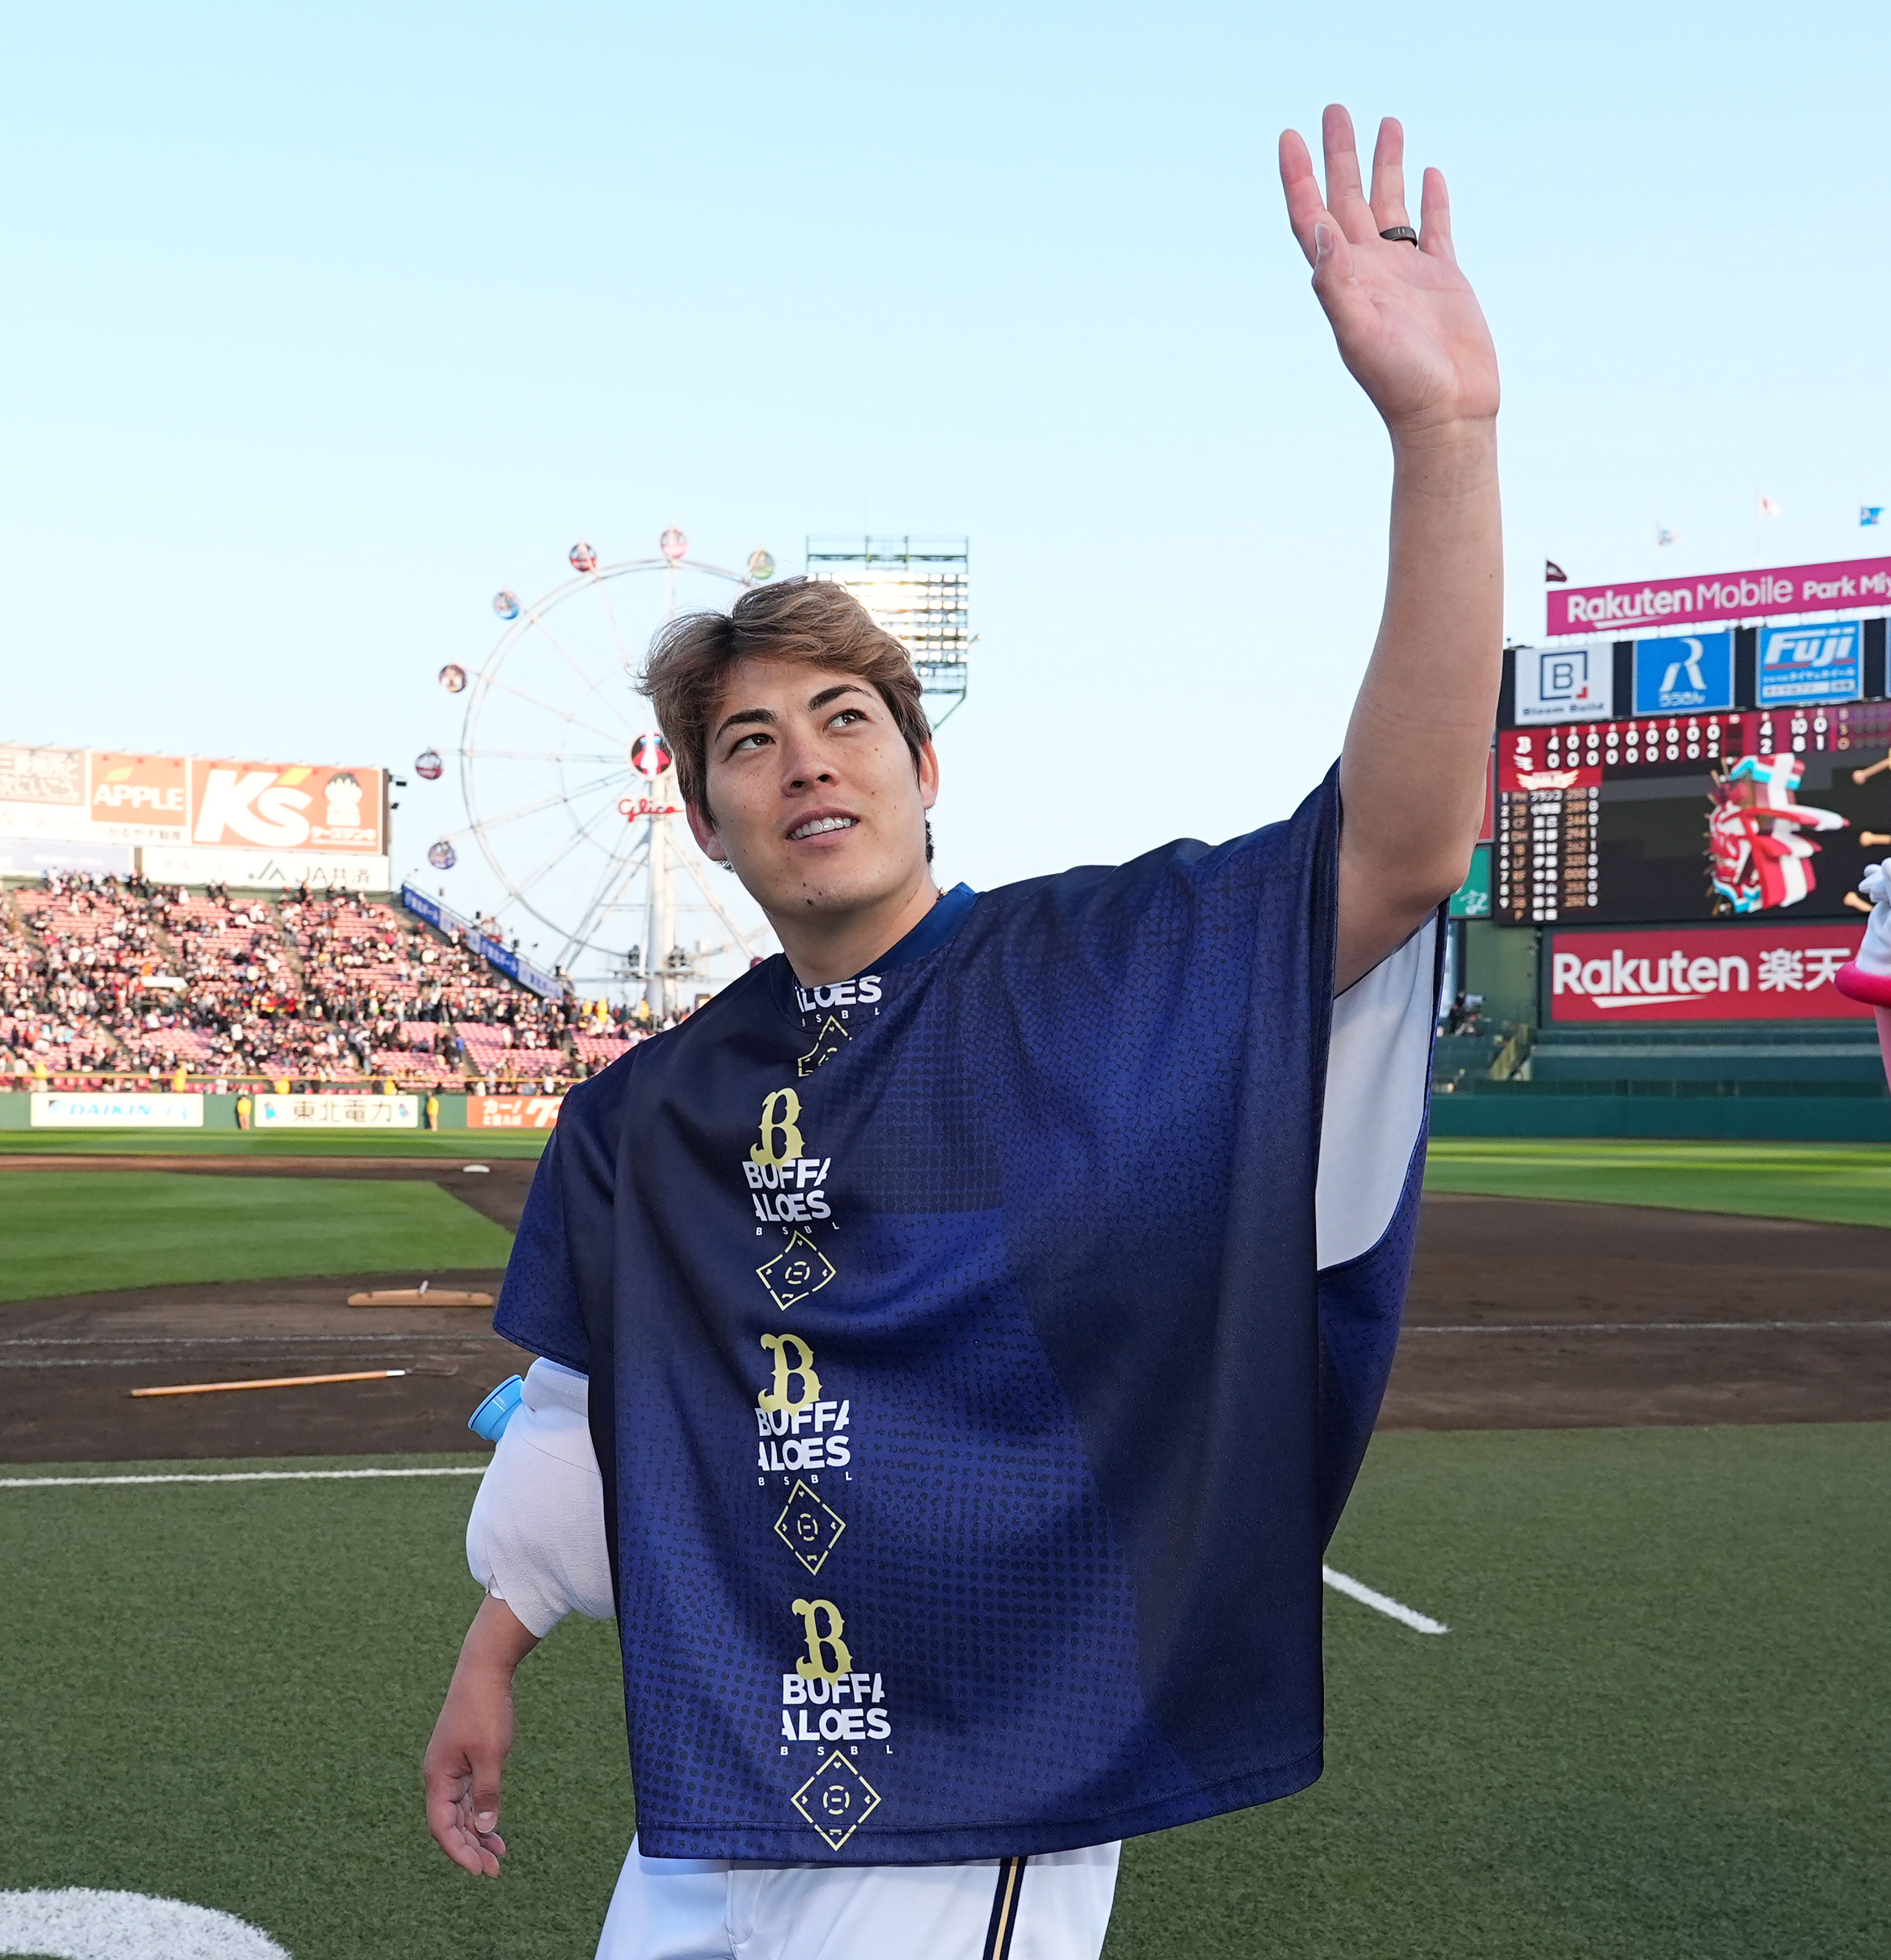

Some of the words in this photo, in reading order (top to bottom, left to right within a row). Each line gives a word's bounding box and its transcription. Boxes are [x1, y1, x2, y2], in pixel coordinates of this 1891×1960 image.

[1568, 587, 1693, 623] Rakuten
[1697, 574, 1794, 610] Mobile
[1802, 575, 1857, 600] Park
[1764, 626, 1856, 667] Fuji
[1554, 663, 1573, 689] B
[1547, 736, 1559, 751] 4
[1567, 735, 1580, 750] 0
[1586, 733, 1600, 748] 0
[1606, 731, 1619, 747] 0
[1625, 730, 1639, 746] 0
[1645, 729, 1659, 744] 0
[1666, 727, 1679, 743] 0
[1686, 726, 1700, 741] 0
[1707, 724, 1720, 740] 0
[1760, 721, 1773, 736] 4
[1791, 717, 1808, 735] 10
[1813, 717, 1828, 733] 0
[1547, 753, 1559, 768] 0
[1567, 751, 1580, 767] 0
[1586, 750, 1600, 766] 0
[1606, 749, 1619, 765] 0
[1625, 747, 1639, 764] 0
[1645, 746, 1659, 762] 0
[1666, 744, 1679, 760] 0
[1686, 743, 1700, 759] 0
[1707, 742, 1719, 758] 2
[1760, 738, 1773, 754] 2
[1816, 734, 1825, 751] 1
[93, 784, 184, 811] APPLE
[193, 767, 313, 847] K's
[1502, 792, 1509, 804] 1
[1588, 786, 1599, 799] 0
[618, 798, 684, 822] Glico
[1500, 804, 1510, 817] 2
[1588, 800, 1599, 813] 0
[1500, 818, 1510, 830] 3
[1588, 813, 1599, 825] 0
[1500, 831, 1509, 843] 4
[1590, 826, 1597, 839] 1
[1590, 840, 1597, 852] 1
[1588, 853, 1598, 866] 0
[1500, 870, 1510, 883] 7
[1588, 867, 1599, 880] 0
[1588, 880, 1598, 893] 0
[1587, 894, 1598, 907] 0
[1553, 949, 1750, 995] Rakuten
[1758, 948, 1852, 992] 楽天
[70, 1104, 151, 1115] DAIKIN
[293, 1099, 391, 1123] 東北電力
[750, 1087, 806, 1171] B
[758, 1334, 823, 1418] B
[792, 1598, 853, 1687] B
